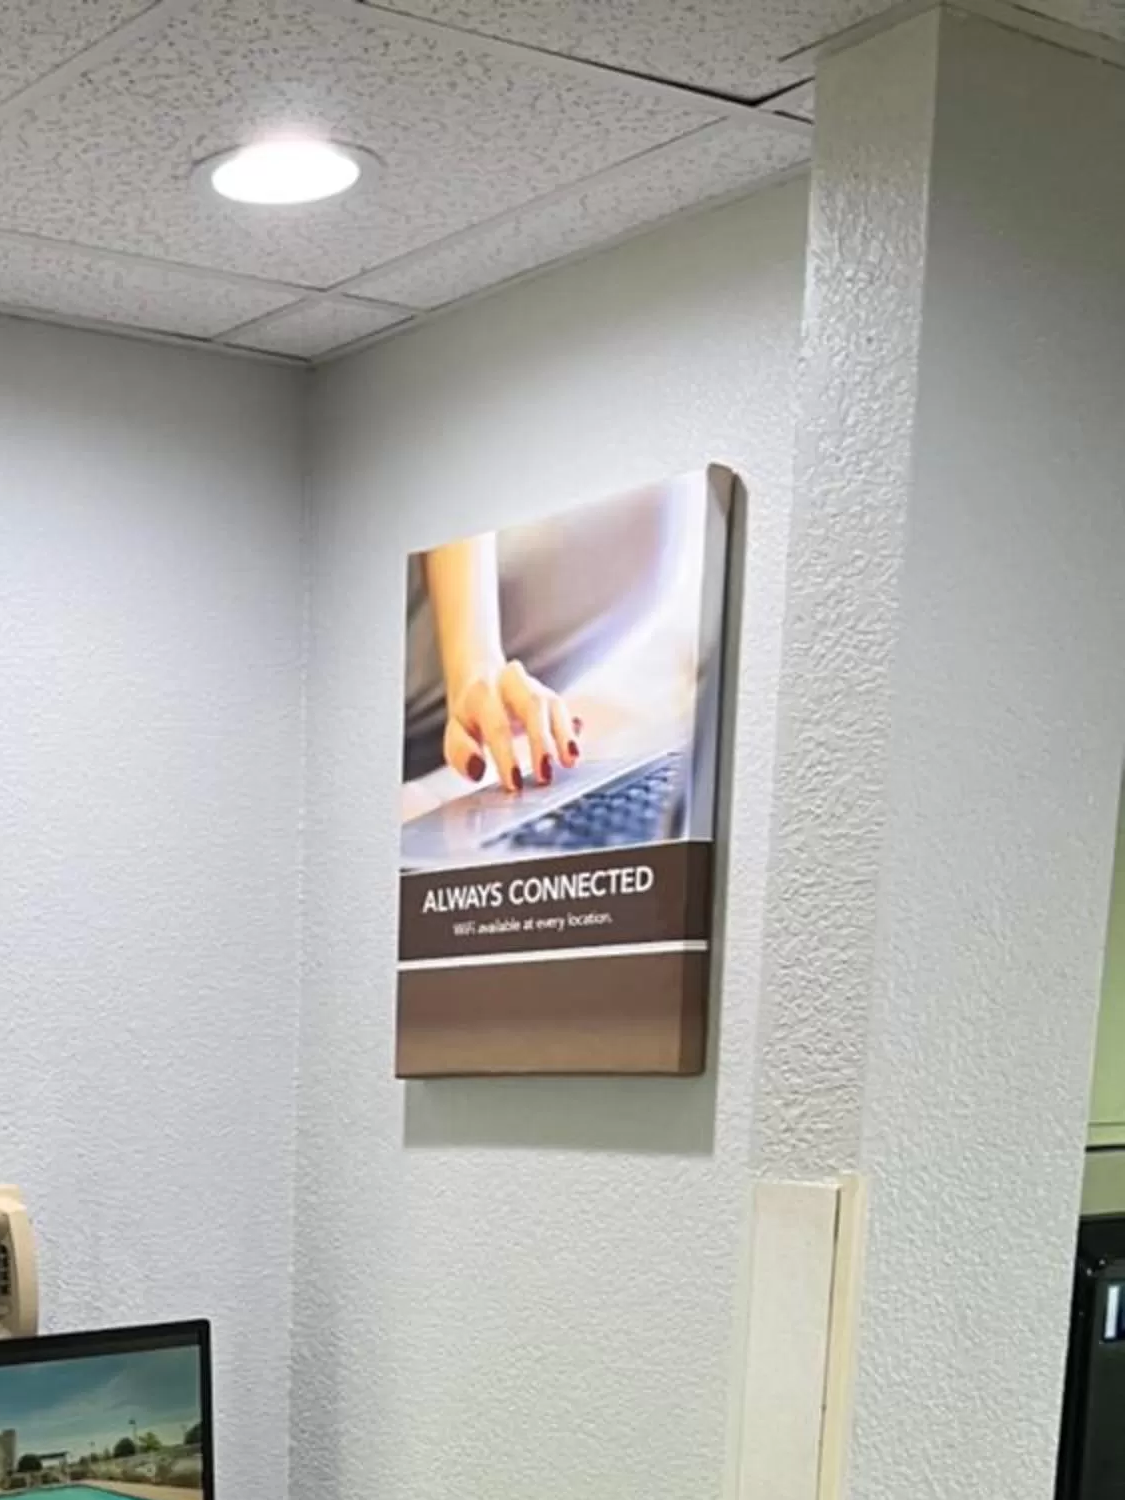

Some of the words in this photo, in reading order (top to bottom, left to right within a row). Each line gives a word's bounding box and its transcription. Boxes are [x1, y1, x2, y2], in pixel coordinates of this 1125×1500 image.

[422, 881, 503, 914] ALWAYS
[508, 865, 654, 906] CONNECTED
[477, 916, 521, 935] available
[523, 917, 534, 931] at
[535, 917, 566, 933] every
